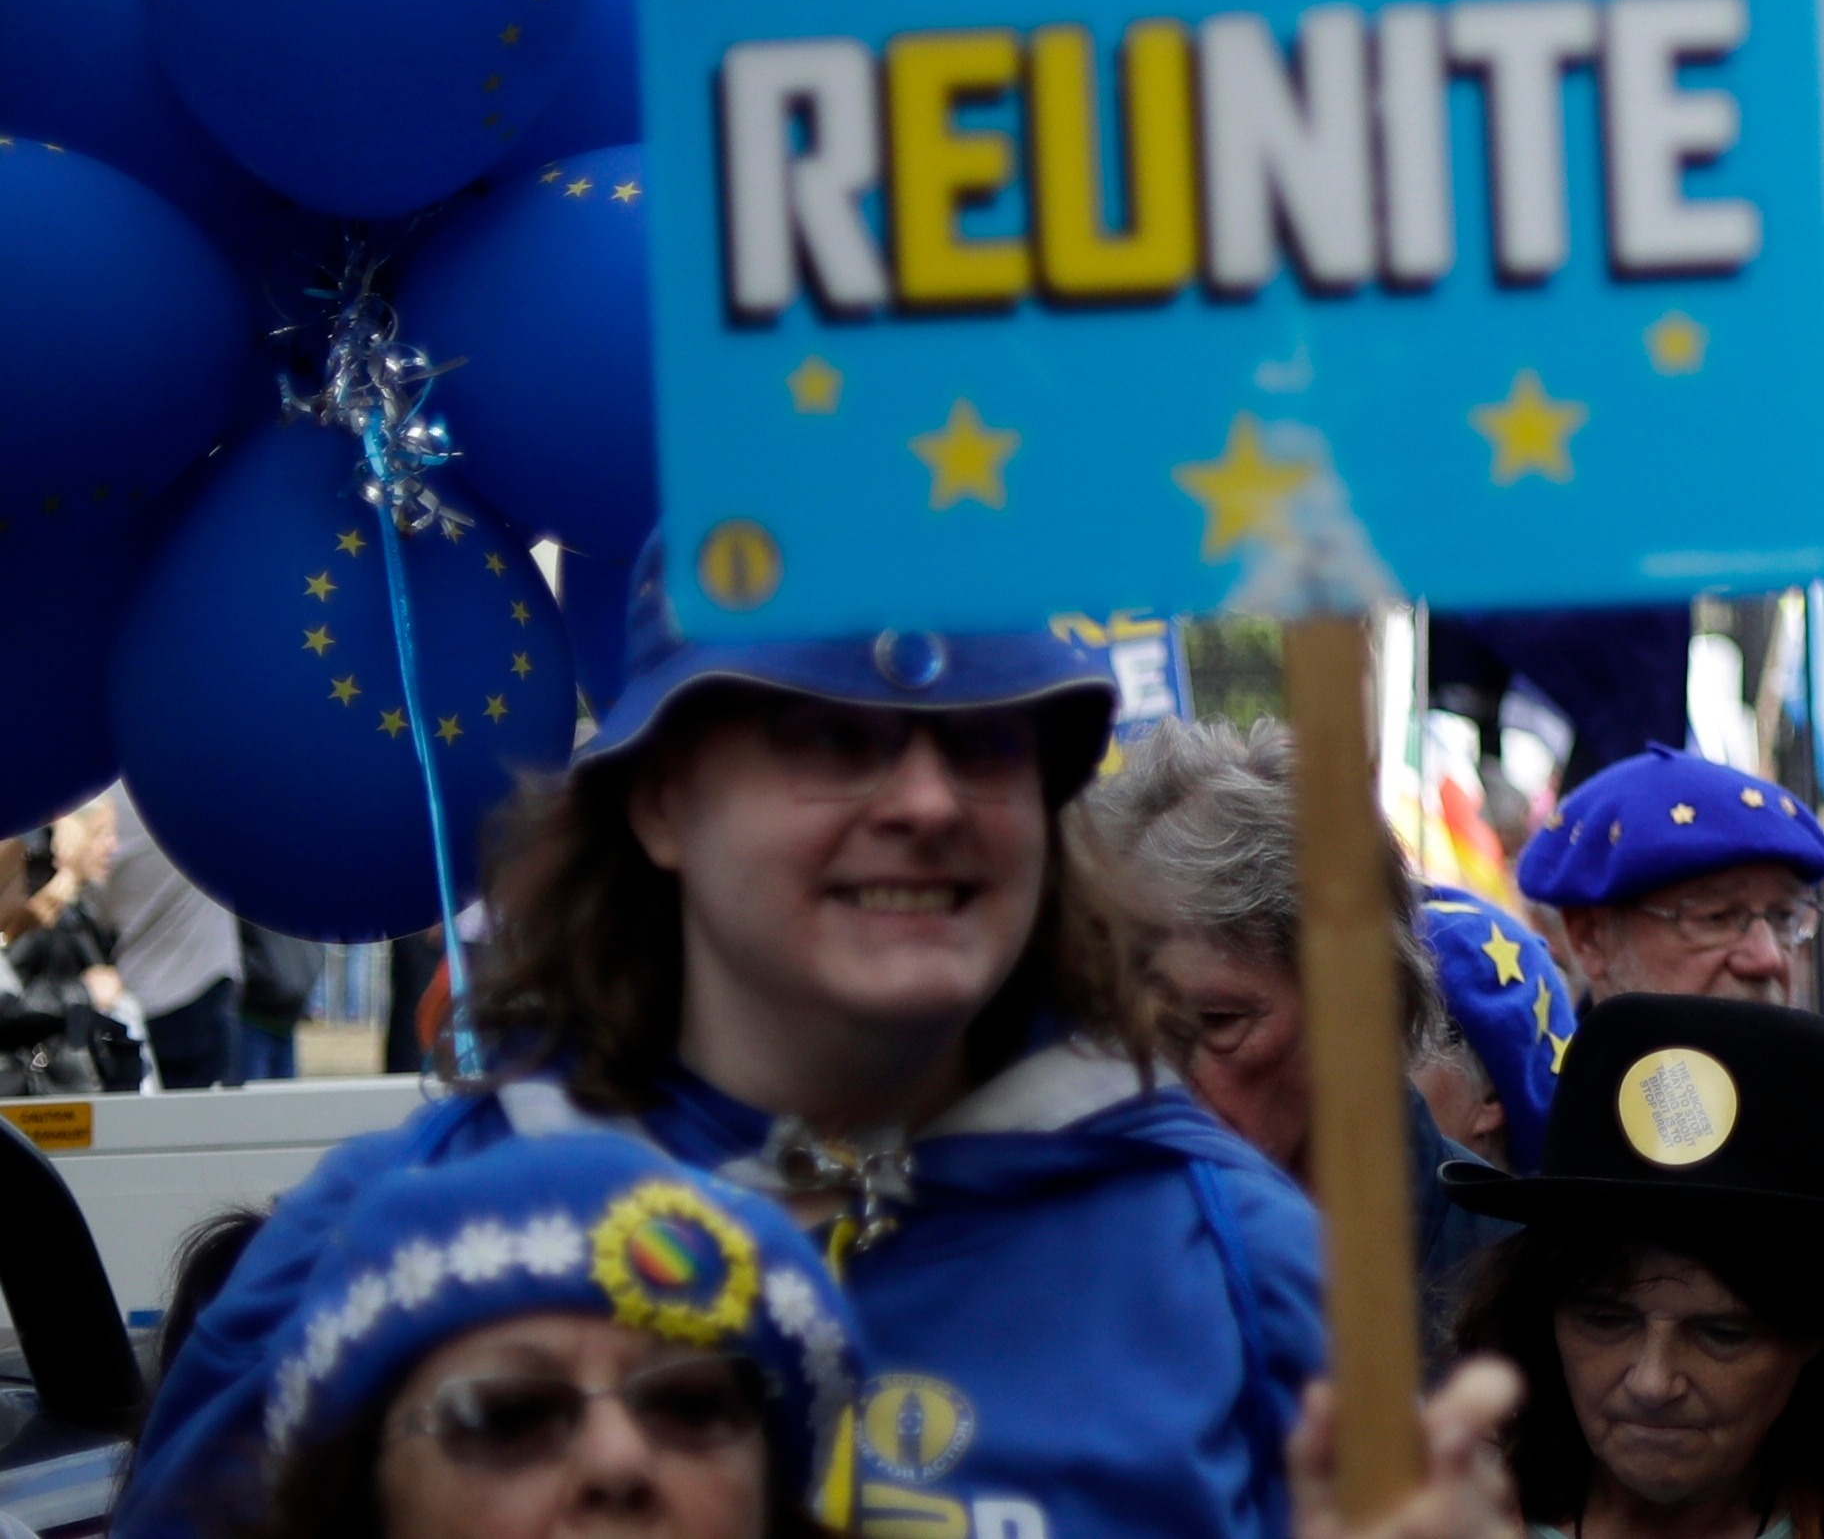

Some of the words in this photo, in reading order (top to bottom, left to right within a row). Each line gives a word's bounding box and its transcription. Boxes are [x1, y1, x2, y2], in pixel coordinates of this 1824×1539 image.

[1641, 1081, 1658, 1110] STOP
[1653, 1112, 1673, 1148] BREXIT
[1649, 1076, 1670, 1113] BREXIT
[1666, 1116, 1674, 1127] IS
[1672, 1129, 1682, 1143] TO
[1657, 1066, 1680, 1109] TALKING
[1676, 1113, 1696, 1147] ABOUT
[1670, 1068, 1683, 1091] WAY
[1679, 1094, 1691, 1107] TO
[1686, 1109, 1703, 1137] STOP
[1678, 1061, 1691, 1083] THE
[1686, 1083, 1713, 1136] QUICKEST
